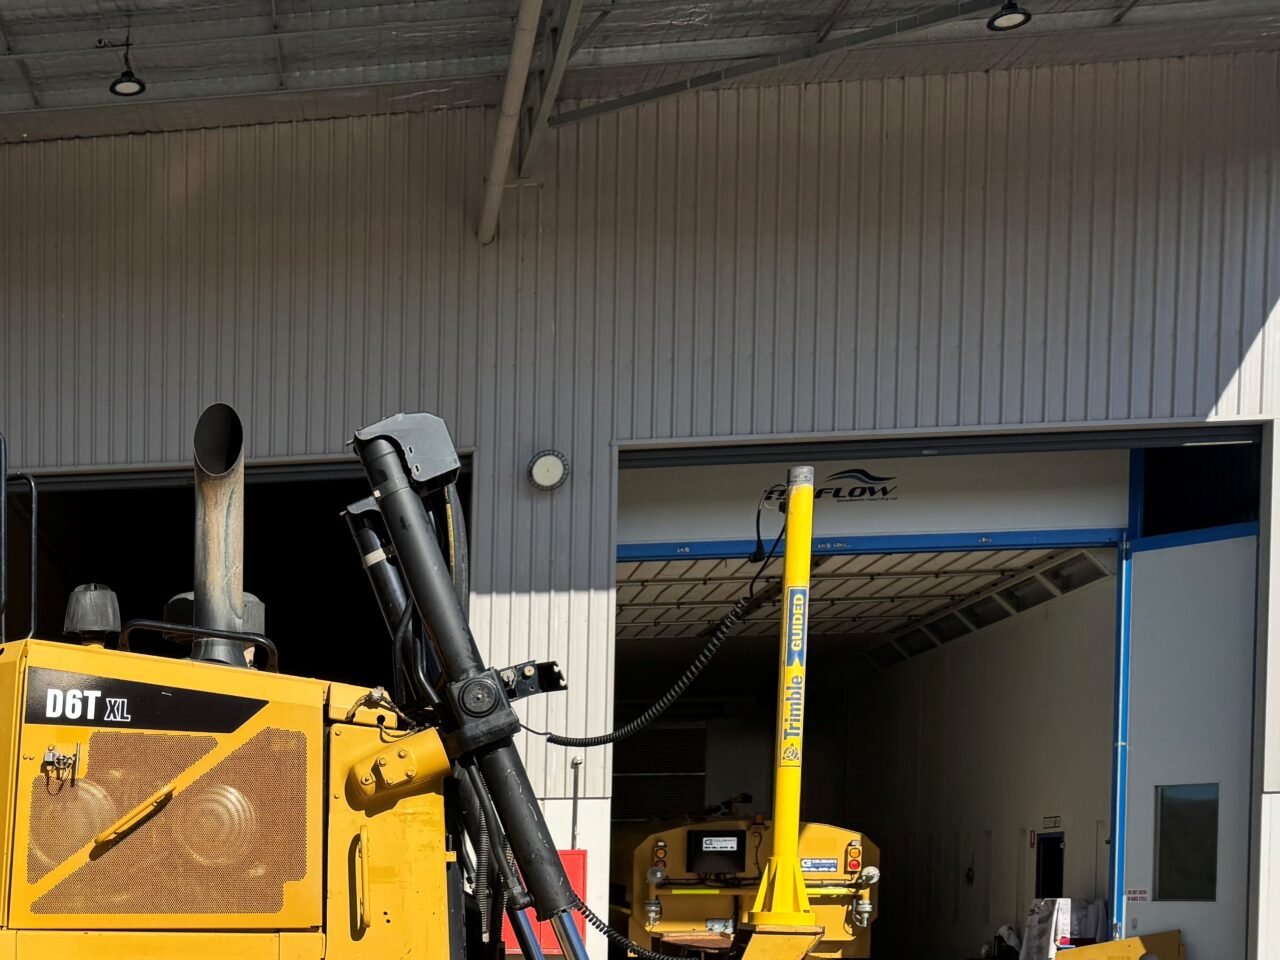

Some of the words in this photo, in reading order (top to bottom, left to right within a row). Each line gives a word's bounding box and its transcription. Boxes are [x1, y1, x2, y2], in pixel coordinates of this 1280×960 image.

[763, 485, 898, 501] AFLOW
[791, 593, 804, 651] GUIDED
[45, 688, 102, 720] D6T
[104, 698, 131, 722] XL
[784, 675, 803, 740] Trimble
